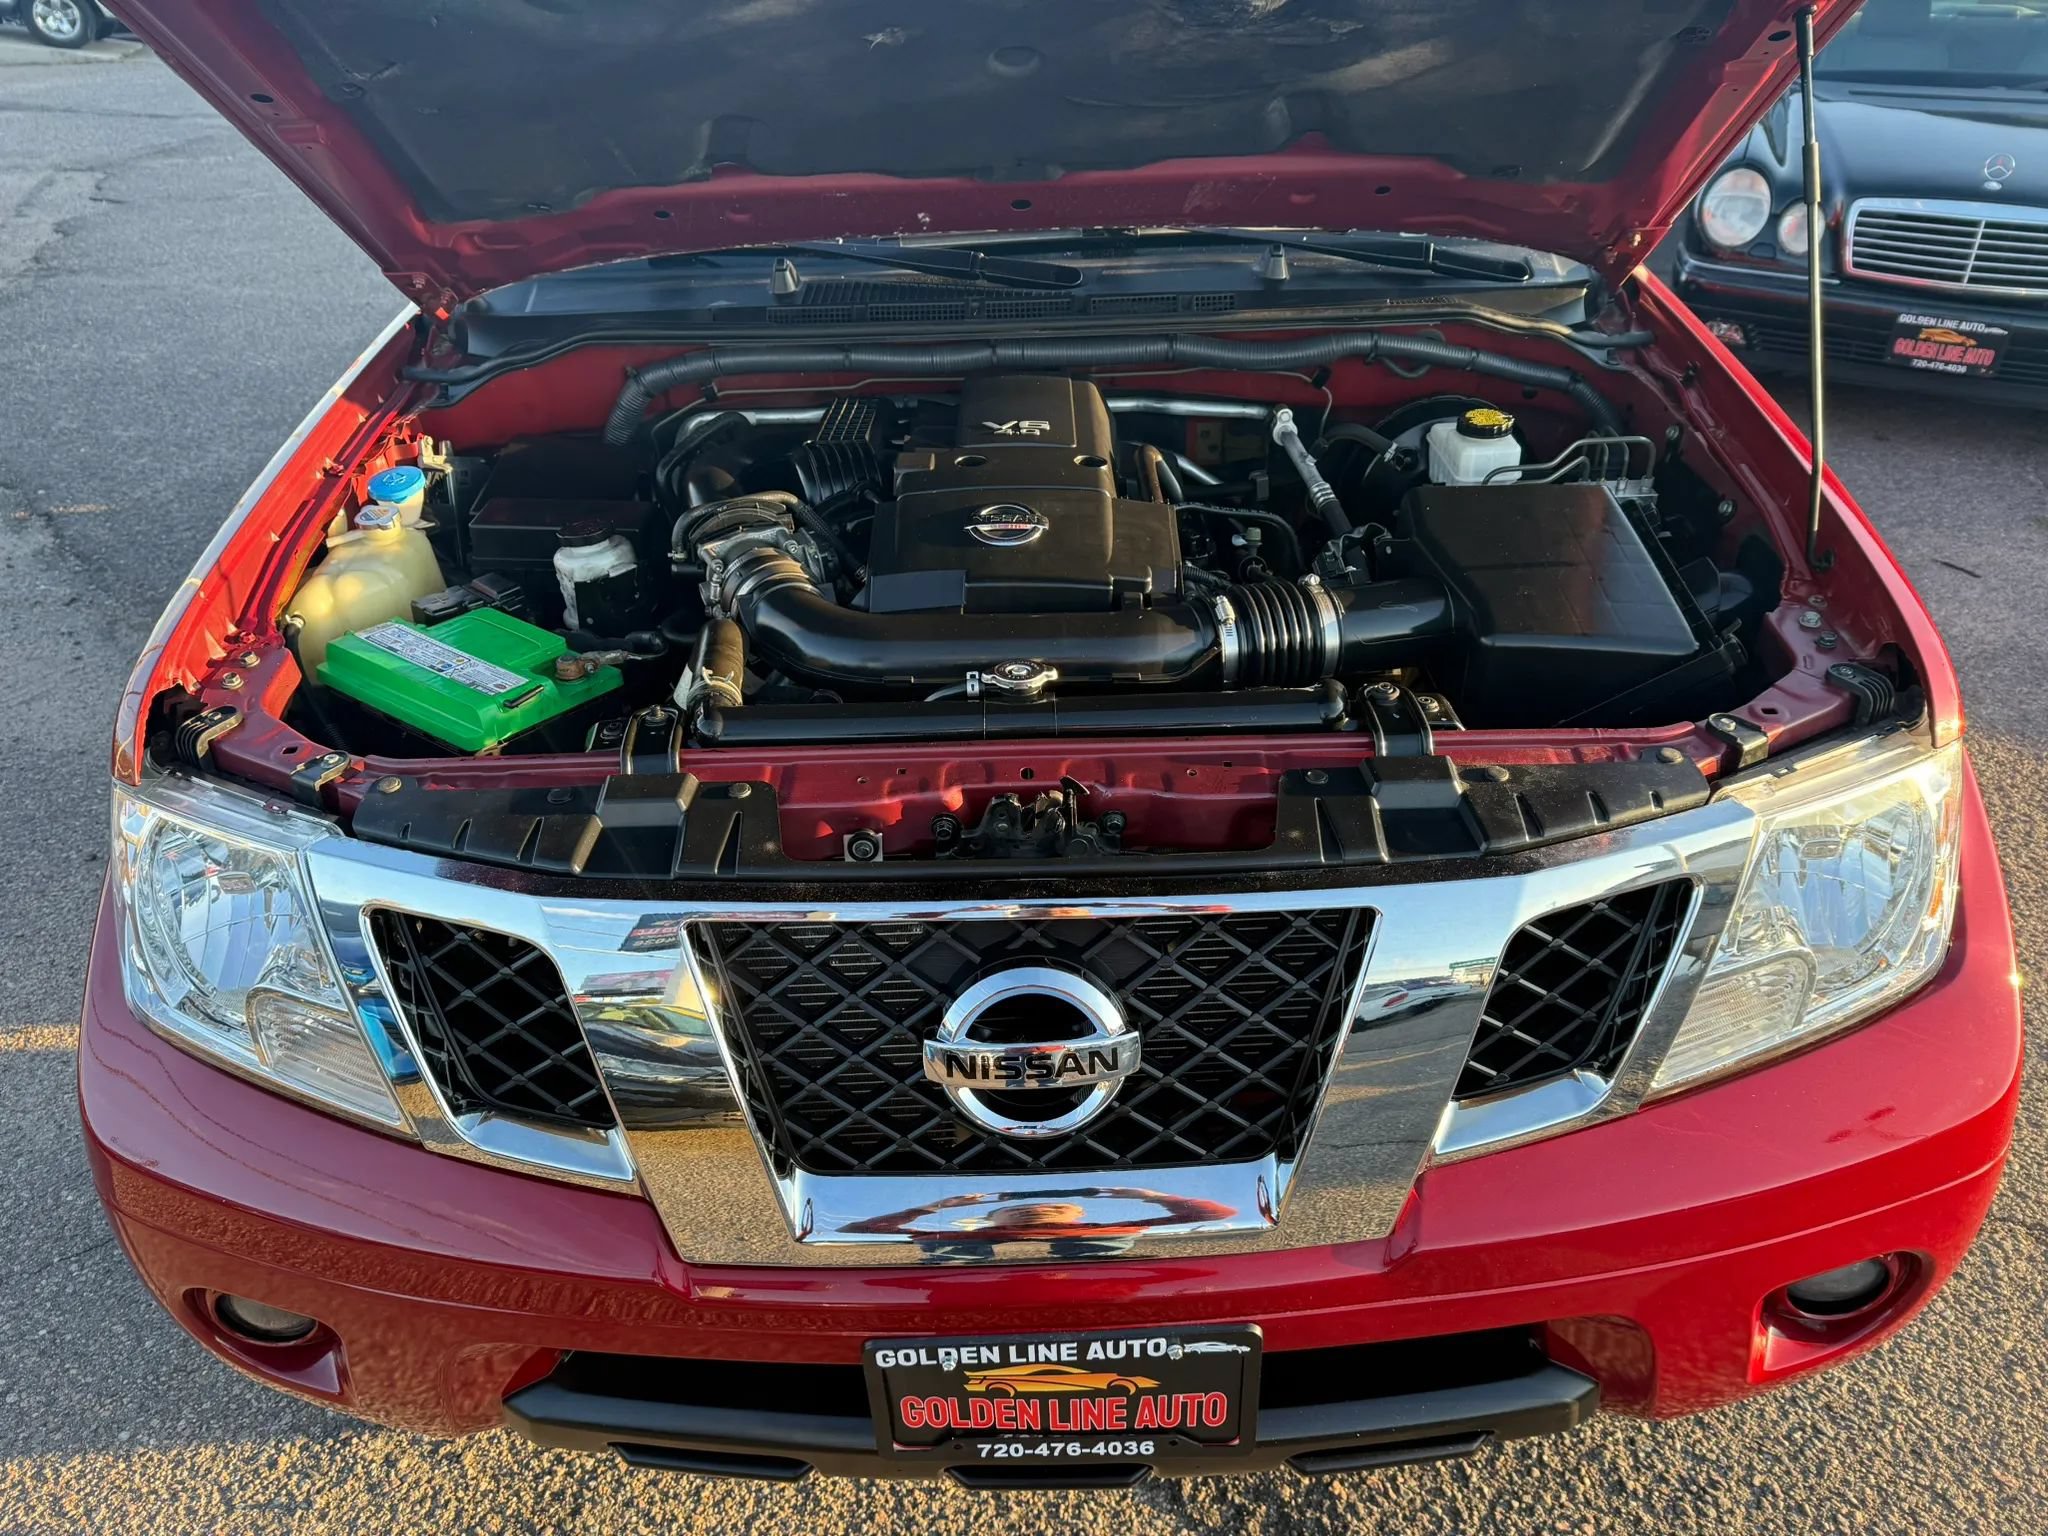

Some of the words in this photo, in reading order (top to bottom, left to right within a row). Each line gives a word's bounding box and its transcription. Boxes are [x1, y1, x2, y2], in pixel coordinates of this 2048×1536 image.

[1899, 313, 1937, 326] GOLDEN
[1937, 318, 1959, 329] LINE
[1959, 321, 1985, 332] AUTO
[1894, 338, 1938, 358] GOLDEN
[1938, 344, 1964, 361] LINE
[1963, 347, 1995, 366] AUTO
[981, 420, 1050, 431] V6
[972, 513, 1038, 523] NISSAN
[946, 1048, 1119, 1080] NISSAN
[875, 1344, 1000, 1369] GOLDEN
[1009, 1343, 1077, 1364] LINE
[1086, 1337, 1168, 1360] AUTO
[899, 1394, 1041, 1430] GOLDEN
[1048, 1397, 1127, 1430] LINE
[1135, 1391, 1228, 1429] AUTO
[976, 1440, 1155, 1458] 720-476-4036
